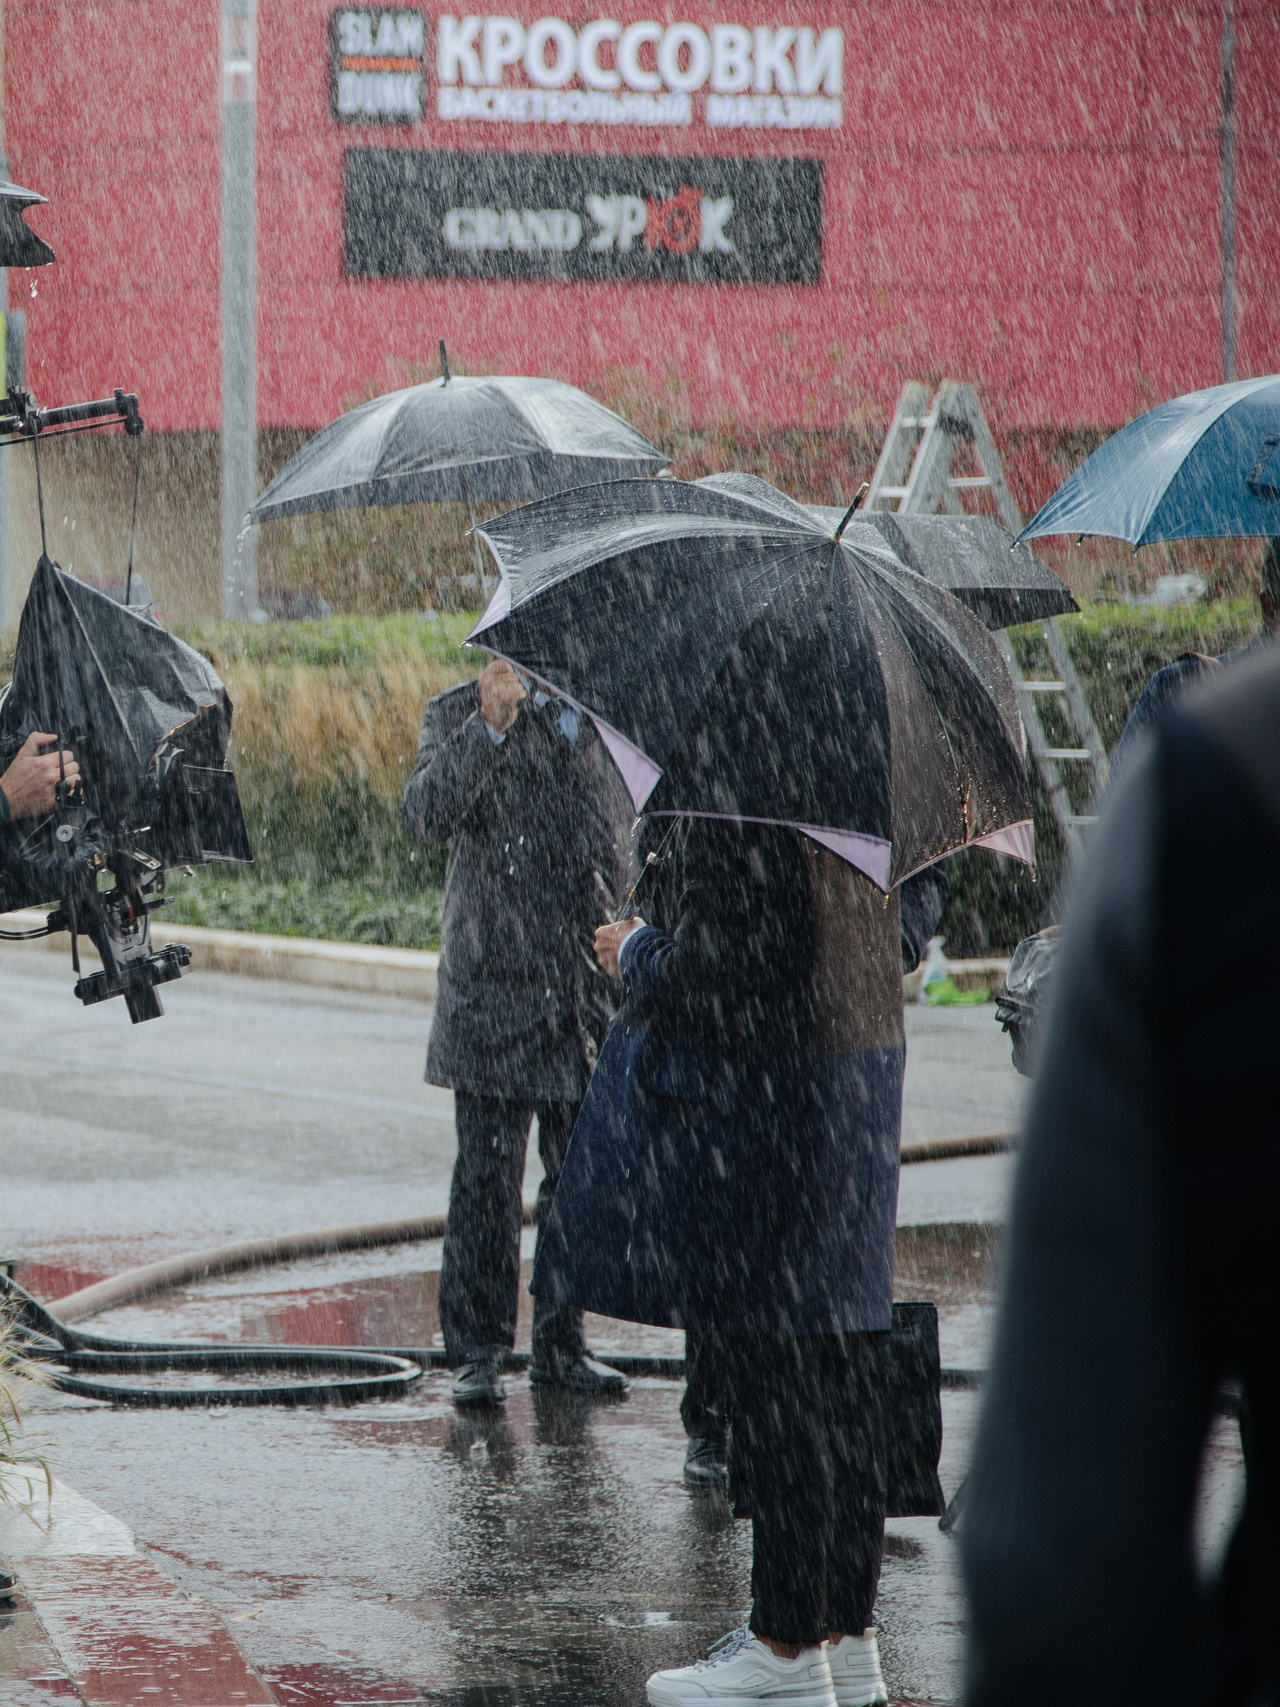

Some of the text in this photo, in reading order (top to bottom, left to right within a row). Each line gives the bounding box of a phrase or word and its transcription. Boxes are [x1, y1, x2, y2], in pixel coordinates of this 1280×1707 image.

[339, 11, 423, 56] SLAM
[437, 16, 844, 95] КРОССОВКИ
[338, 70, 421, 116] DUNK
[442, 207, 582, 251] GRAND
